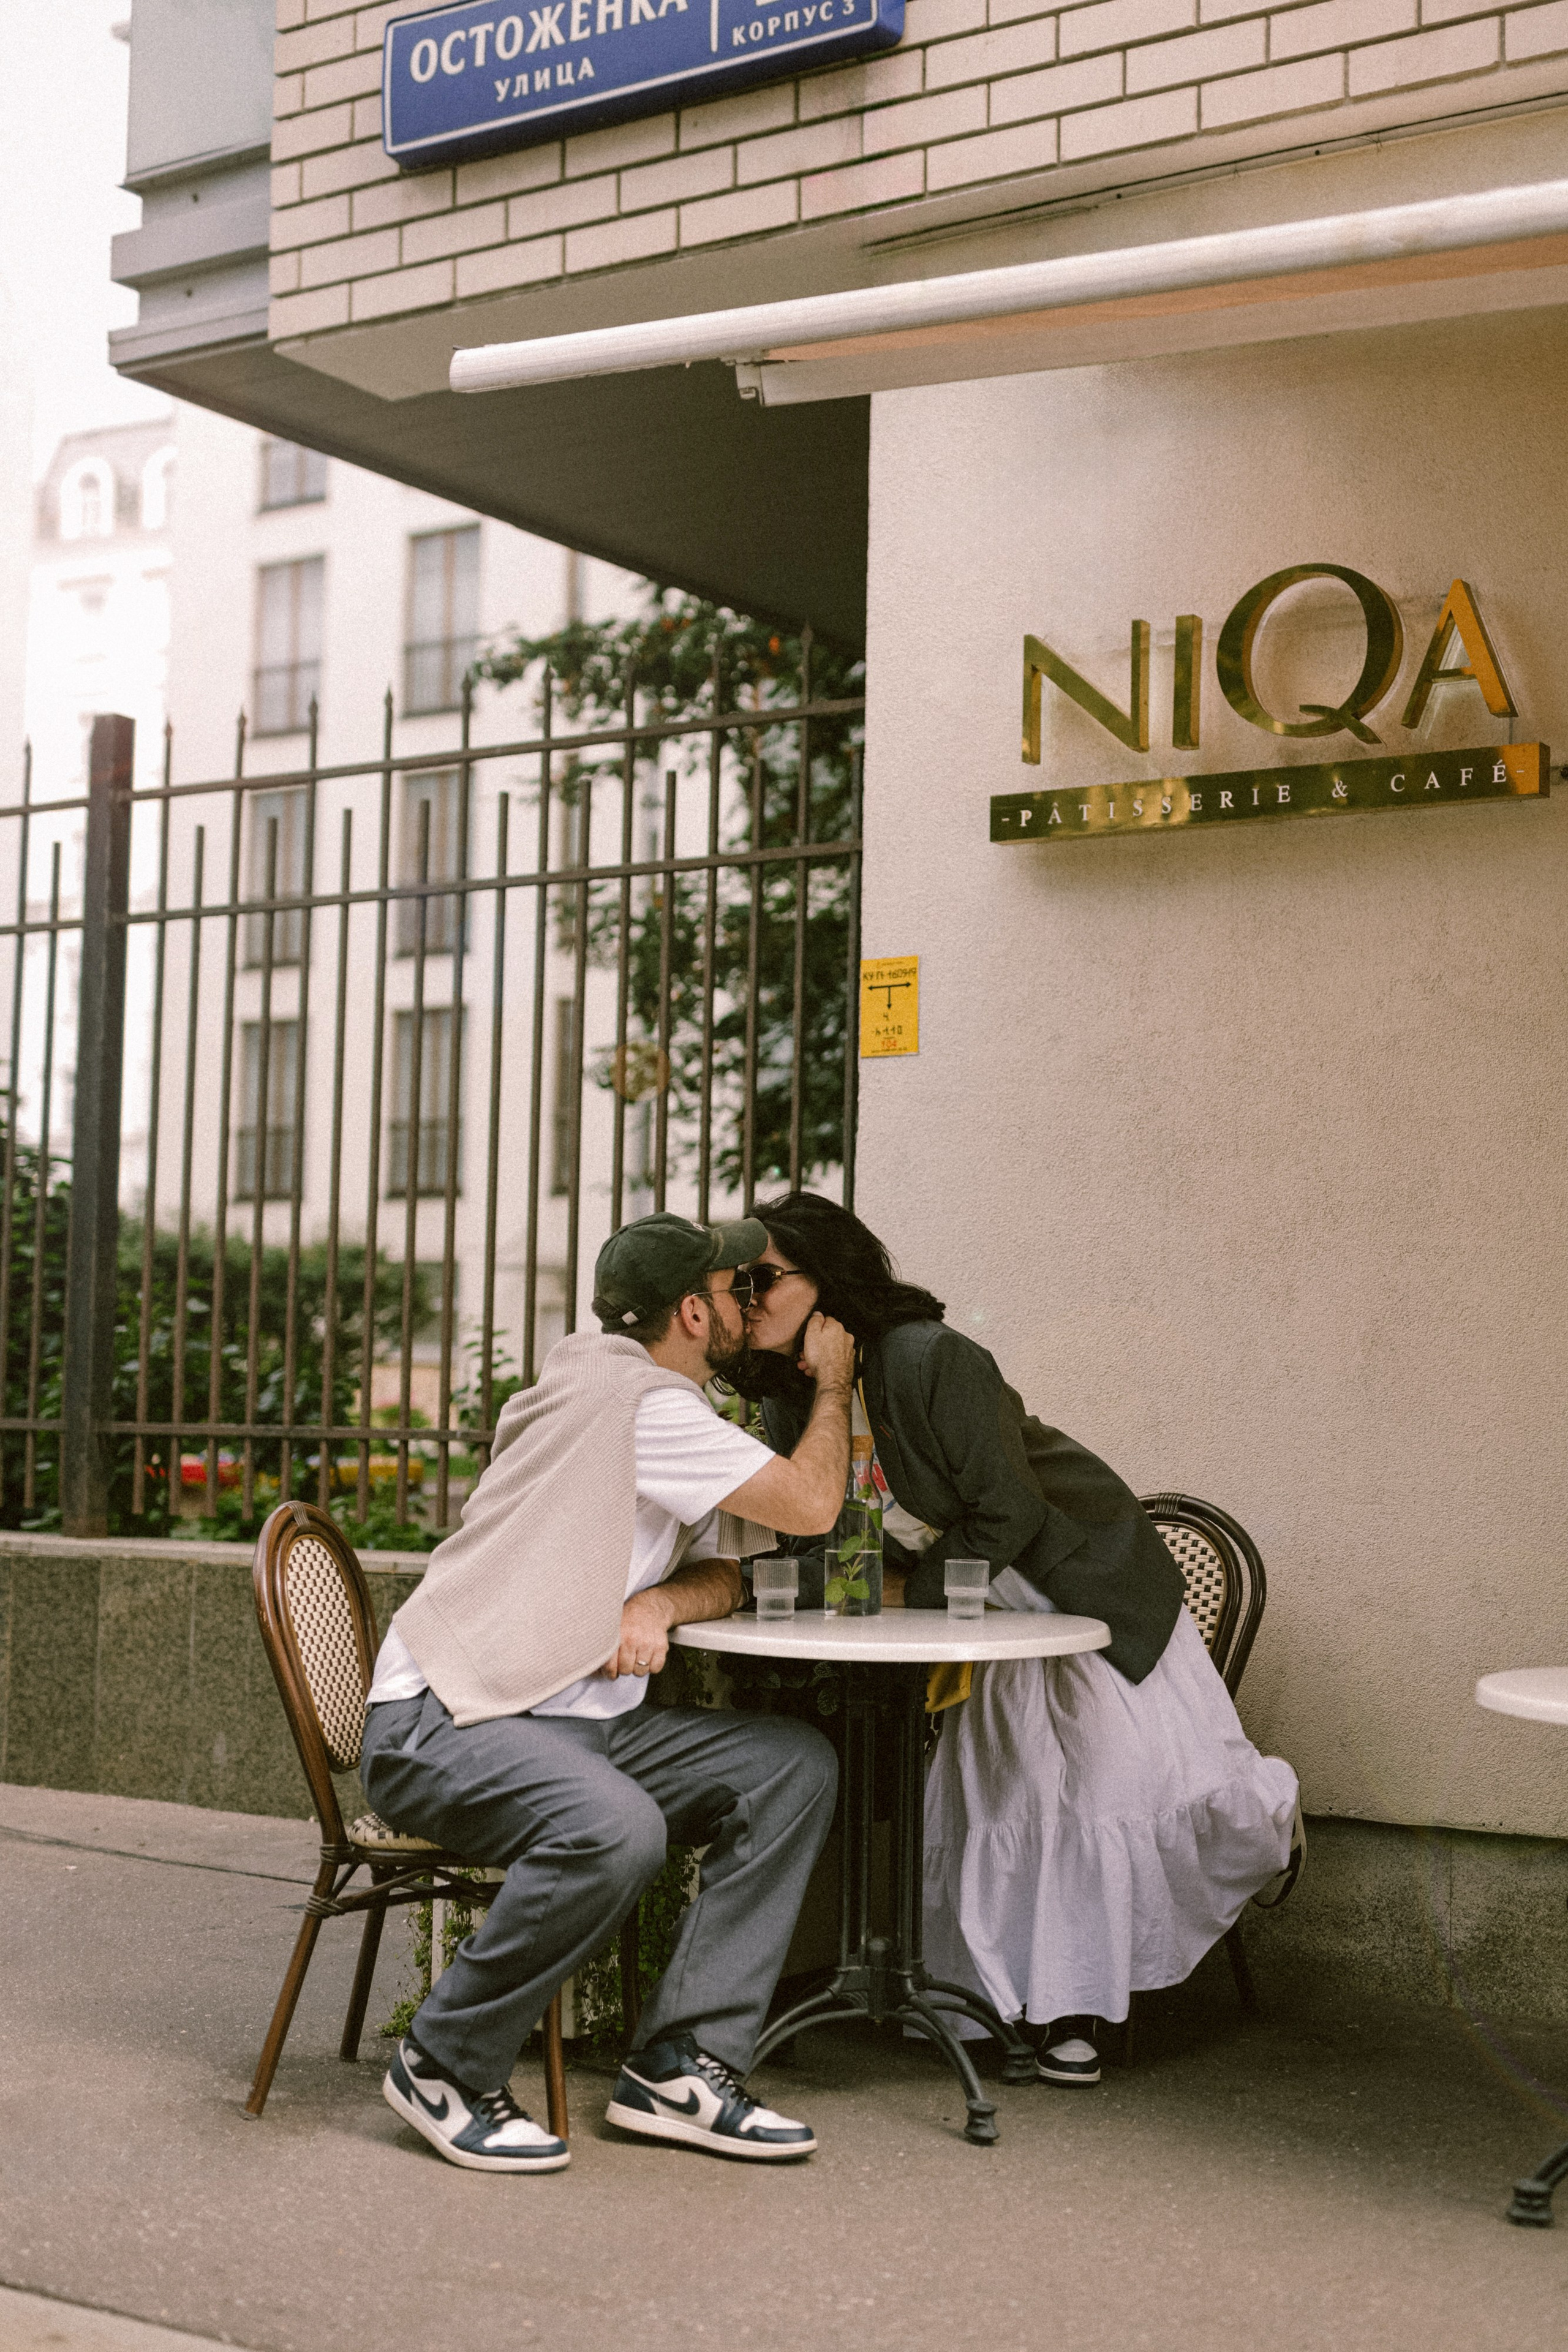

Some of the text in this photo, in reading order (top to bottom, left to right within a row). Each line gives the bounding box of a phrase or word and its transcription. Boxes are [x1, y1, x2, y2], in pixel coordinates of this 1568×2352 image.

[732, 0, 855, 46] КОРПУС 3
[494, 57, 595, 102] УЛИЦА
[1022, 563, 1519, 766] NIQA
[1332, 778, 1349, 799] &
